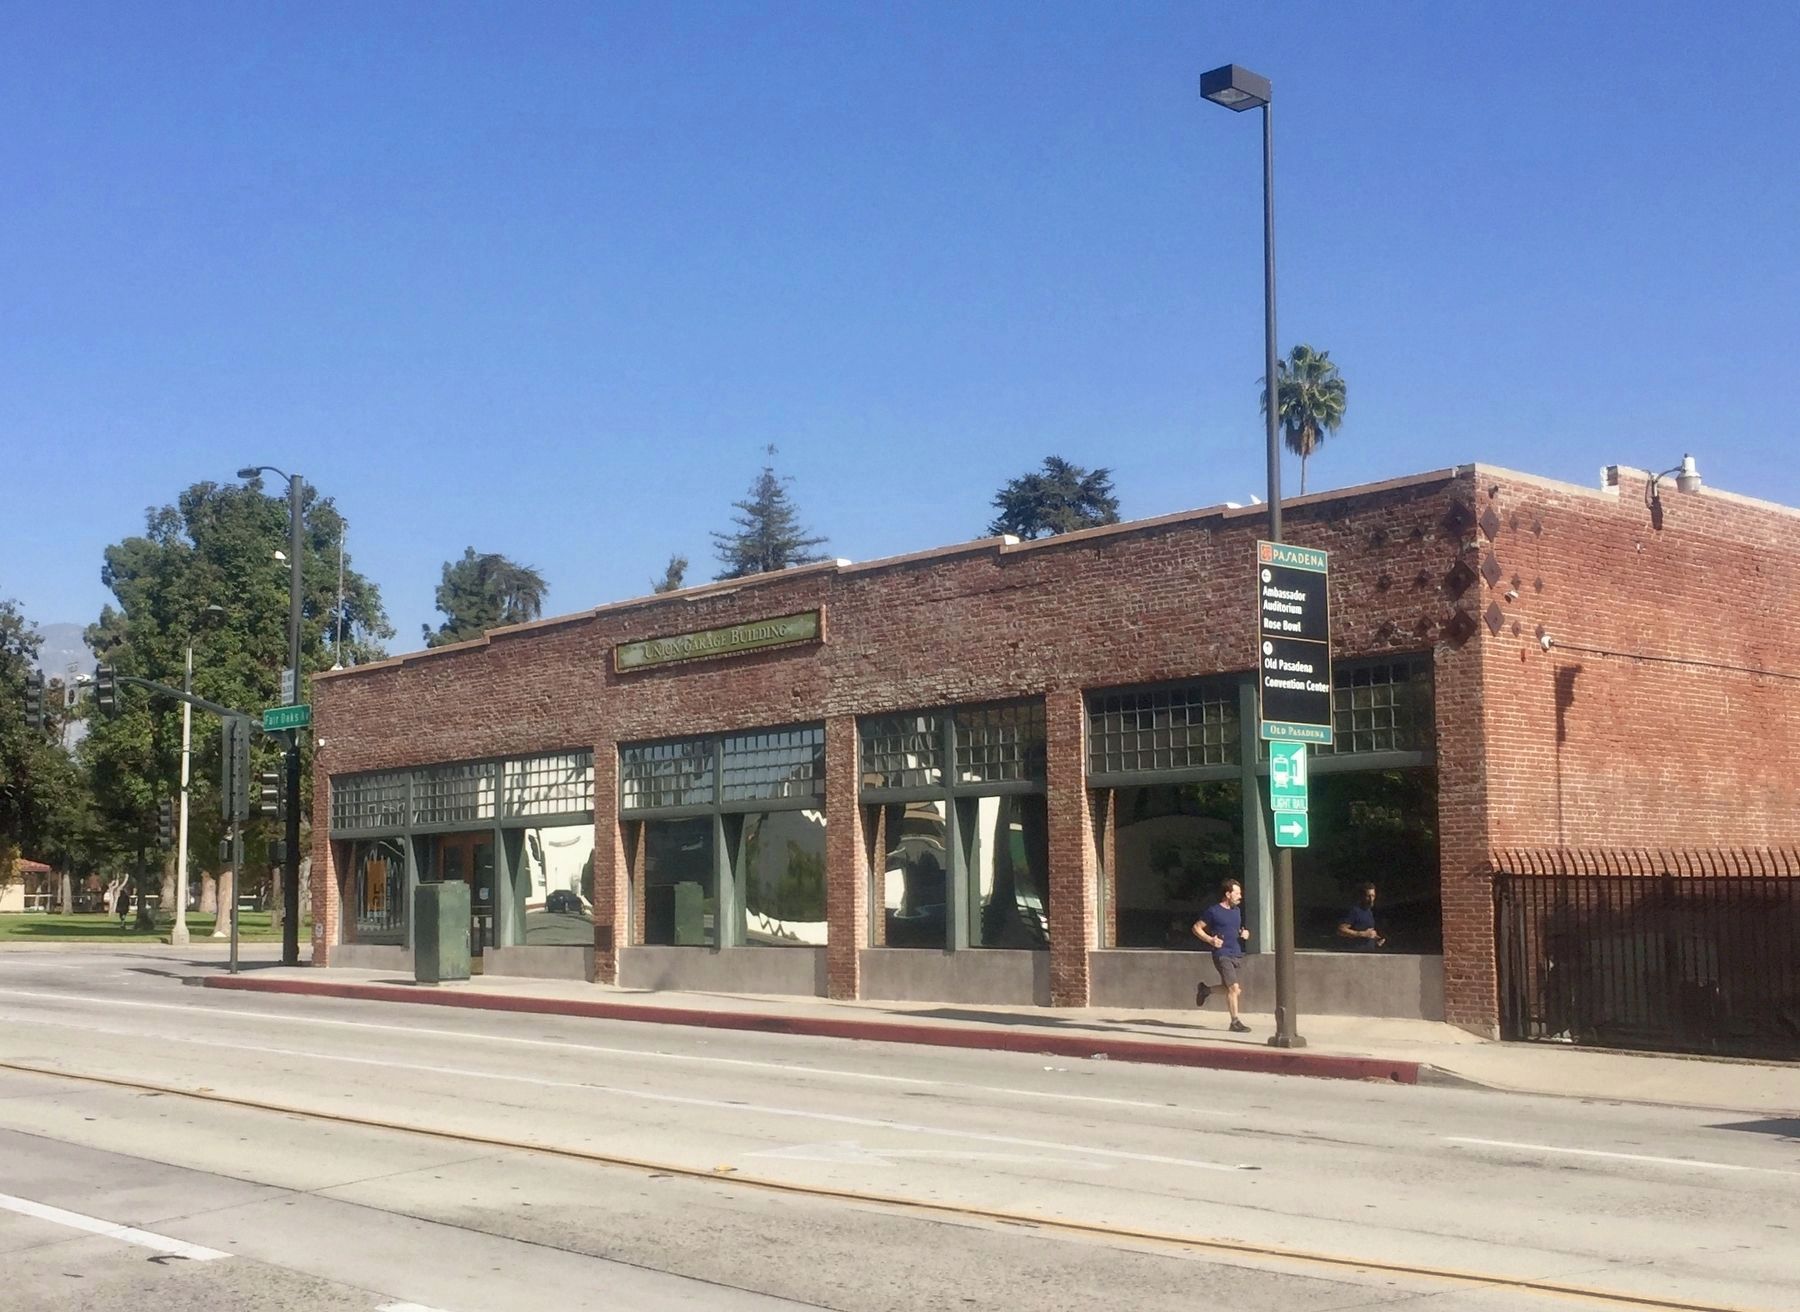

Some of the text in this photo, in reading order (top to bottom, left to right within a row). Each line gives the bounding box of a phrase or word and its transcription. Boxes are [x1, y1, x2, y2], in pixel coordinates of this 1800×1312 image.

[1273, 550, 1325, 567] PASADENA
[1262, 586, 1306, 601] Ambassador
[1263, 600, 1303, 615] Auditorium
[1263, 618, 1302, 632] Rose Bowl
[731, 623, 787, 646] BUILDING
[1264, 658, 1313, 673] Old Pasadena
[1264, 676, 1330, 692] Convention Center
[265, 714, 279, 726] Fair
[280, 712, 299, 724] Oaks
[1270, 725, 1324, 738] OLD PASADENA
